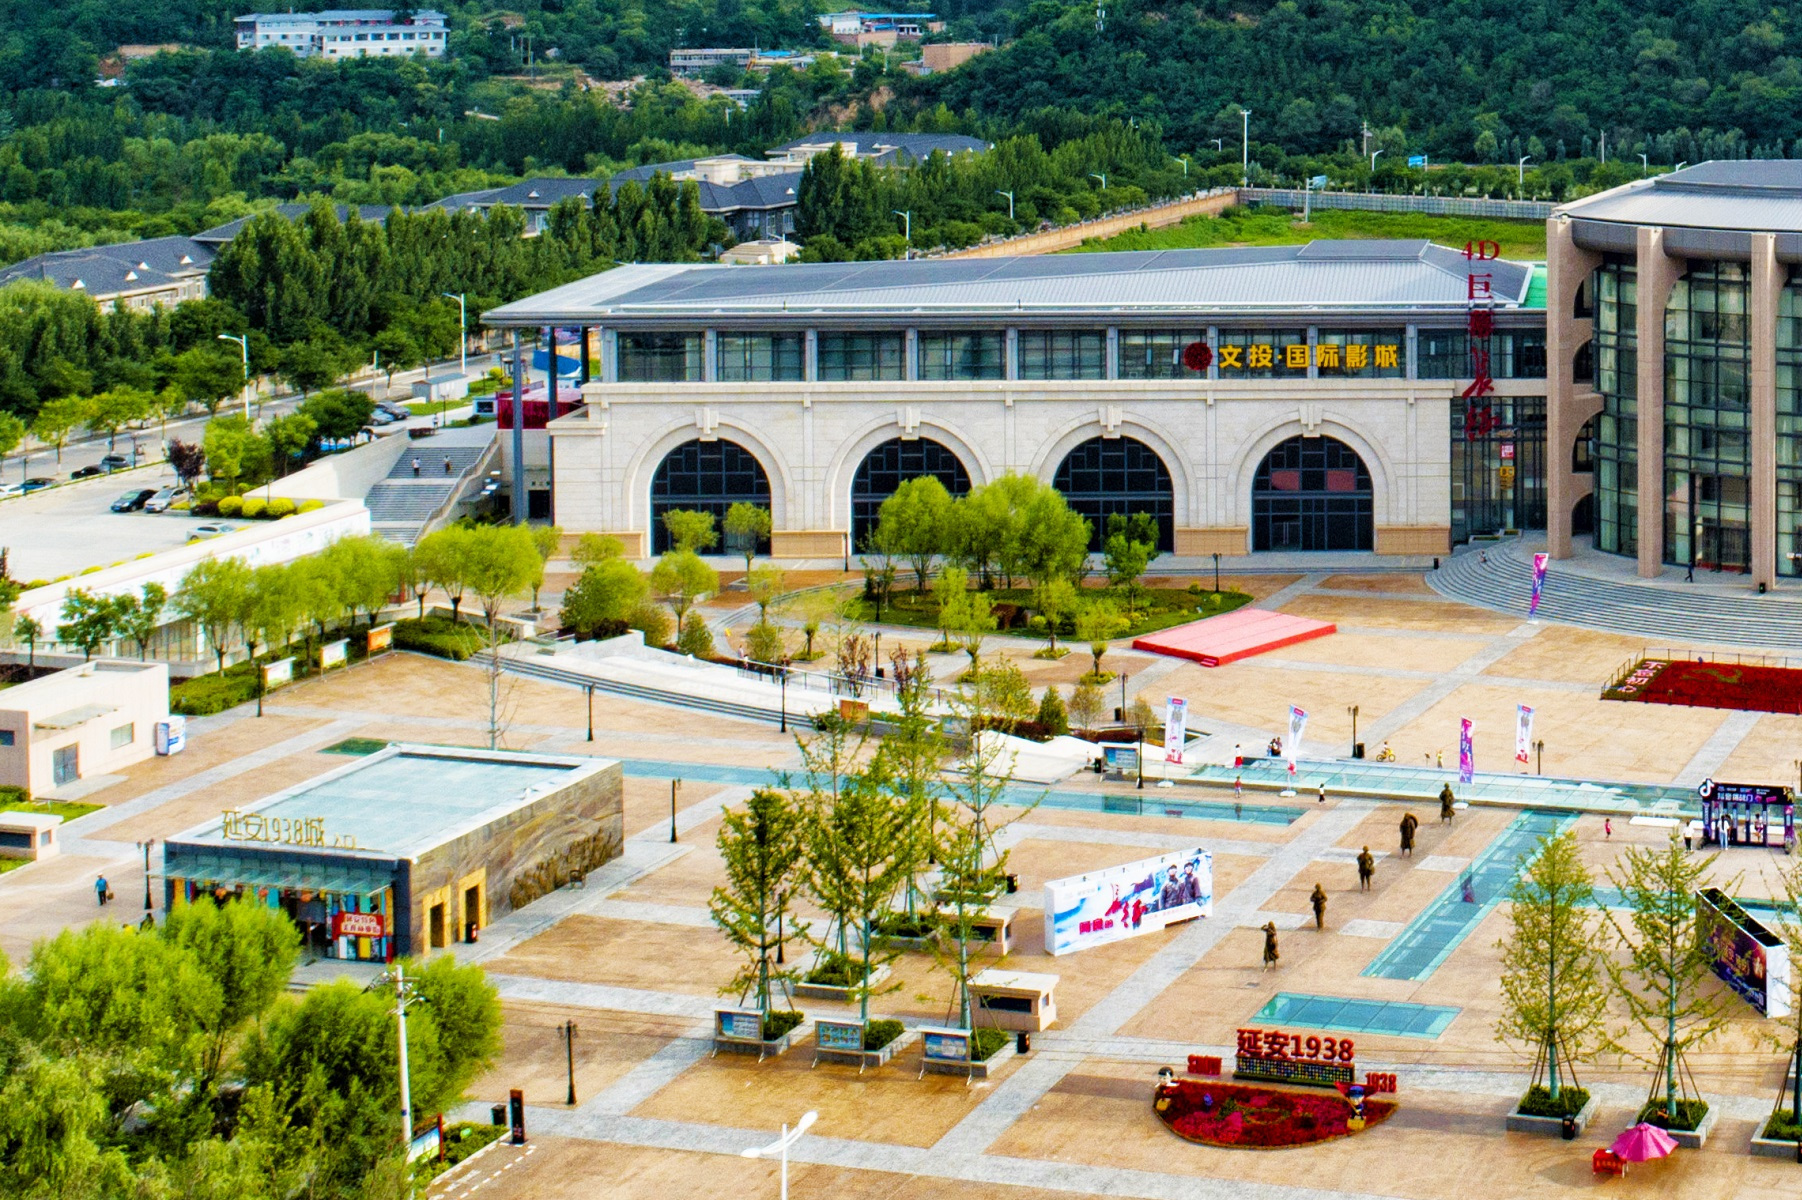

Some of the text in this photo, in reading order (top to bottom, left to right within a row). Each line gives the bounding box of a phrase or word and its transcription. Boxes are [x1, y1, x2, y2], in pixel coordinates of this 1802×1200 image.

[1219, 344, 1398, 369] 文投·国际影城
[1617, 661, 1667, 692] 不忘初心
[221, 809, 325, 847] 延安1938城
[1236, 1028, 1355, 1062] 延安1938
[1365, 1071, 1398, 1094] 1938
